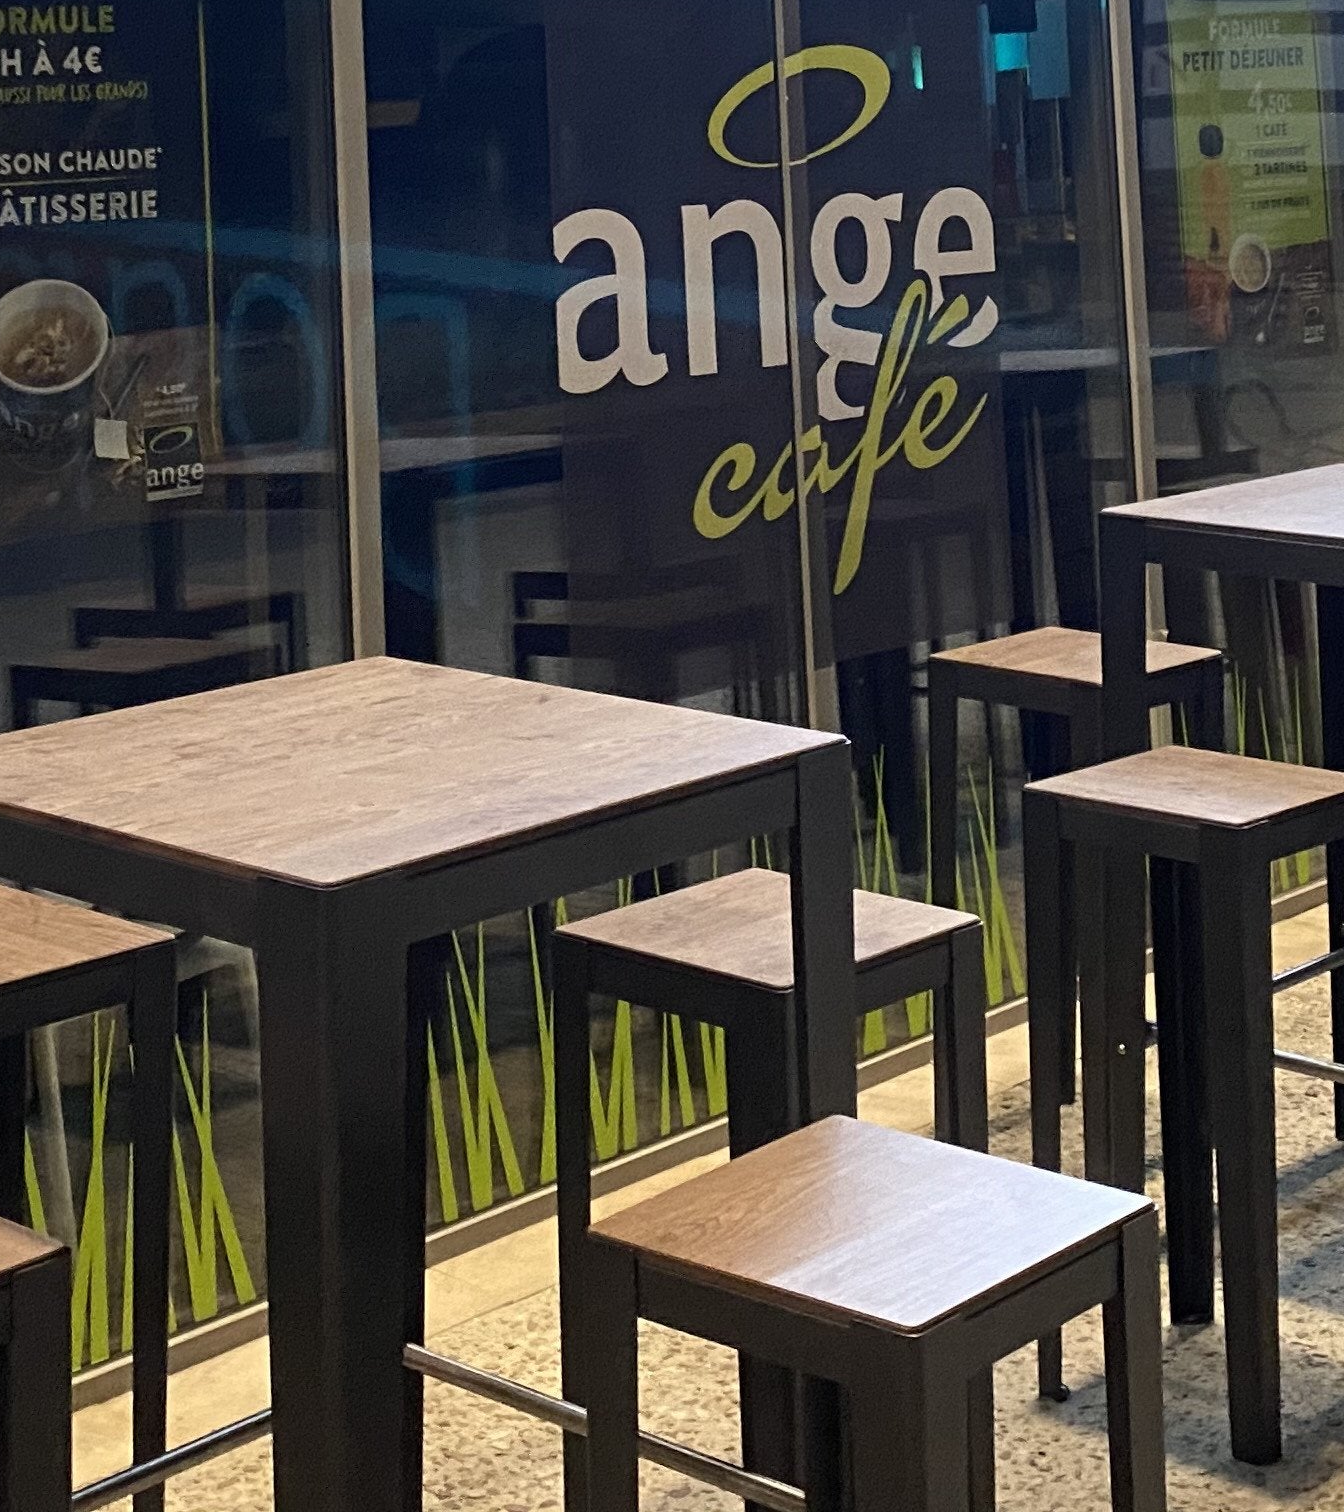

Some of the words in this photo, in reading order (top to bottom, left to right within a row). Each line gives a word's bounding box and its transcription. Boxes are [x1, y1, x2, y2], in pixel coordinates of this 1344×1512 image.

[32, 39, 54, 76] À
[63, 46, 103, 74] 4€
[1182, 50, 1225, 72] PETIT
[1230, 43, 1304, 70] DÉJEUNER
[553, 187, 999, 421] ange
[692, 279, 987, 595] café
[146, 462, 204, 490] ange
